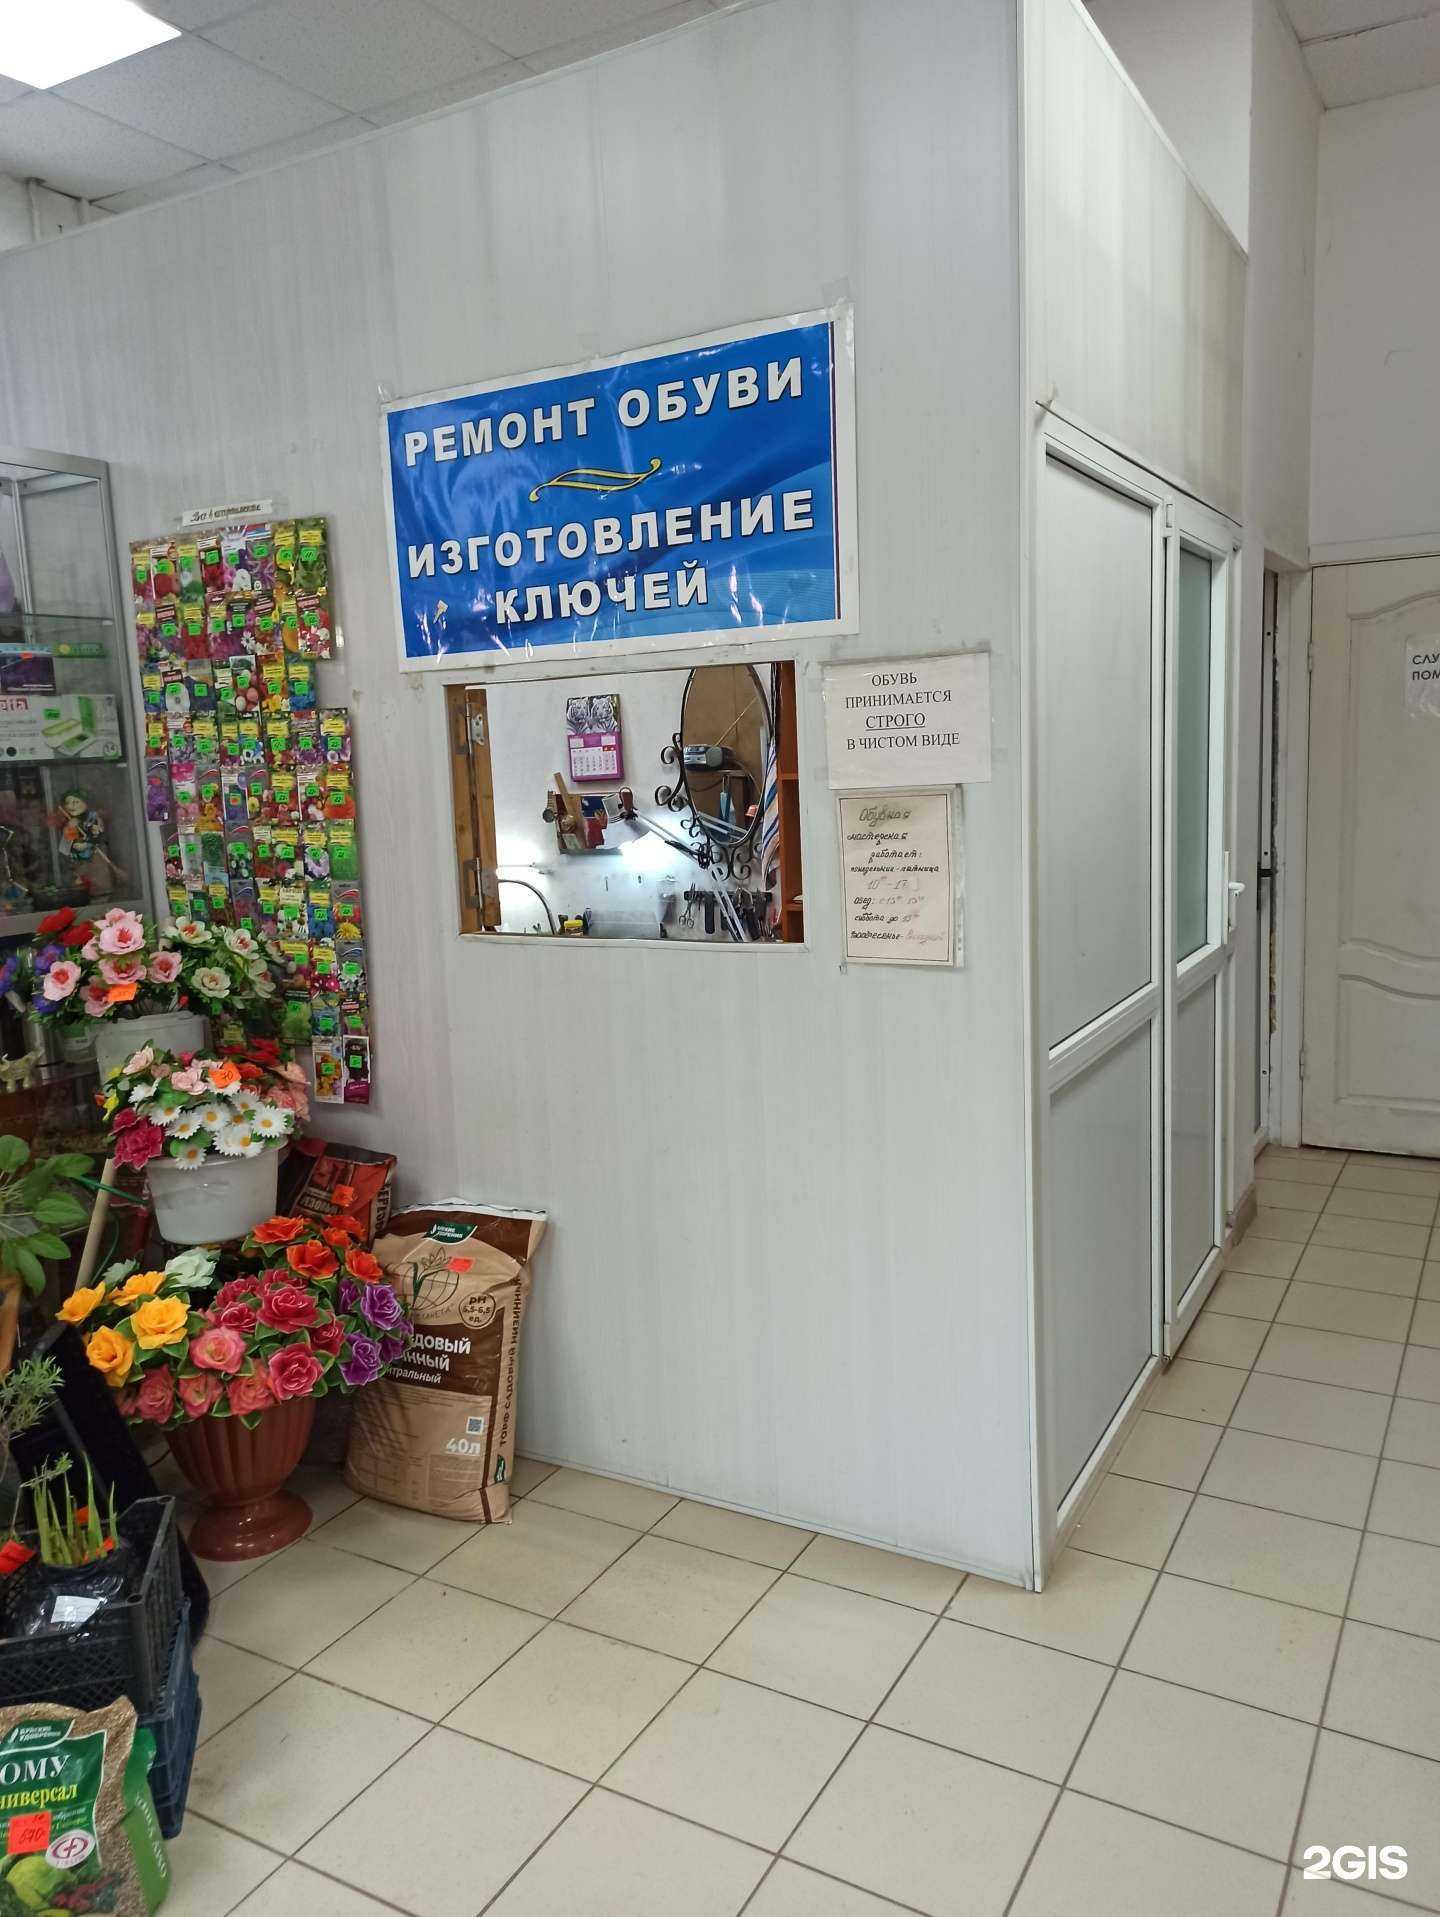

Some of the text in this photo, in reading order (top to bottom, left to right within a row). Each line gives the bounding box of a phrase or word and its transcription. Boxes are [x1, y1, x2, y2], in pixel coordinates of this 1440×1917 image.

[405, 357, 803, 466] РЕМОНТ ОБУВИ
[408, 490, 814, 578] ИЗГОТОВЛЕНИЕ
[495, 560, 708, 625] КЛЮЧЕЙ
[872, 672, 918, 686] ОБУВЬ
[845, 690, 952, 708] ПРИНИМАЕТСЯ
[865, 713, 926, 729] СТРОГО
[847, 733, 960, 750] В ЧИСТОМ ВИДЕ
[414, 1334, 471, 1354] ДОВЫЙ
